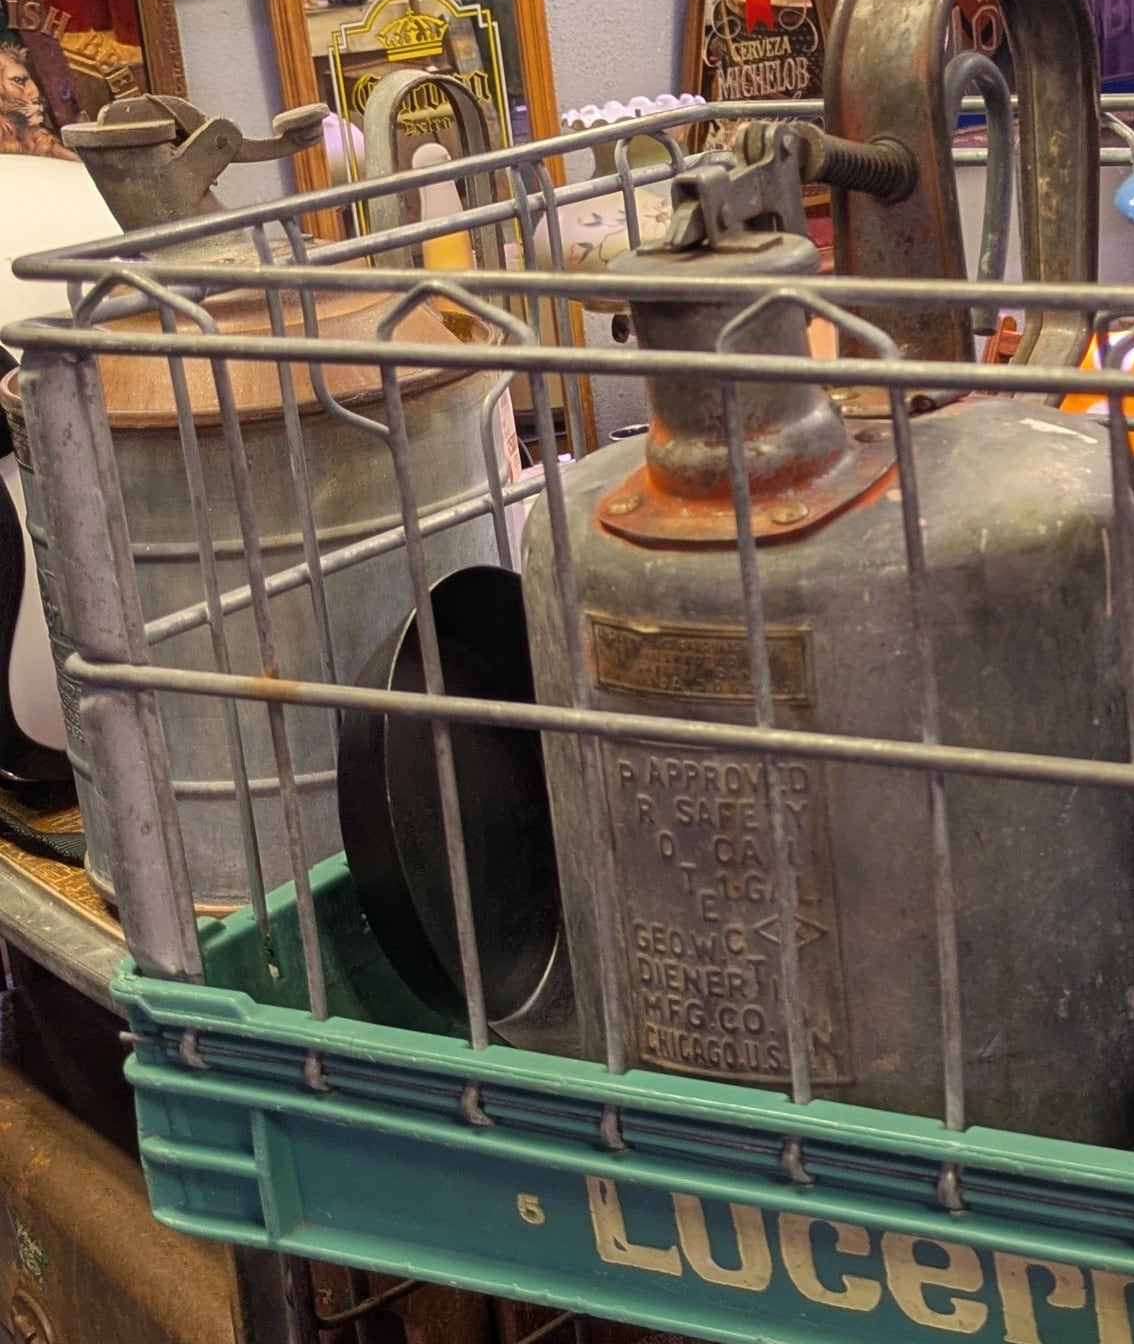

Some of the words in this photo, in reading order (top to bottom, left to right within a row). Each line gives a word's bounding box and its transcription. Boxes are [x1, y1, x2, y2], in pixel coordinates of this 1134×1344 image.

[77, 27, 140, 100] BEE
[731, 35, 793, 62] CERVEZA
[716, 57, 811, 102] MICHELOB
[672, 794, 808, 834] SAFEY
[636, 953, 748, 1000] DIENER
[515, 1192, 546, 1226] 5
